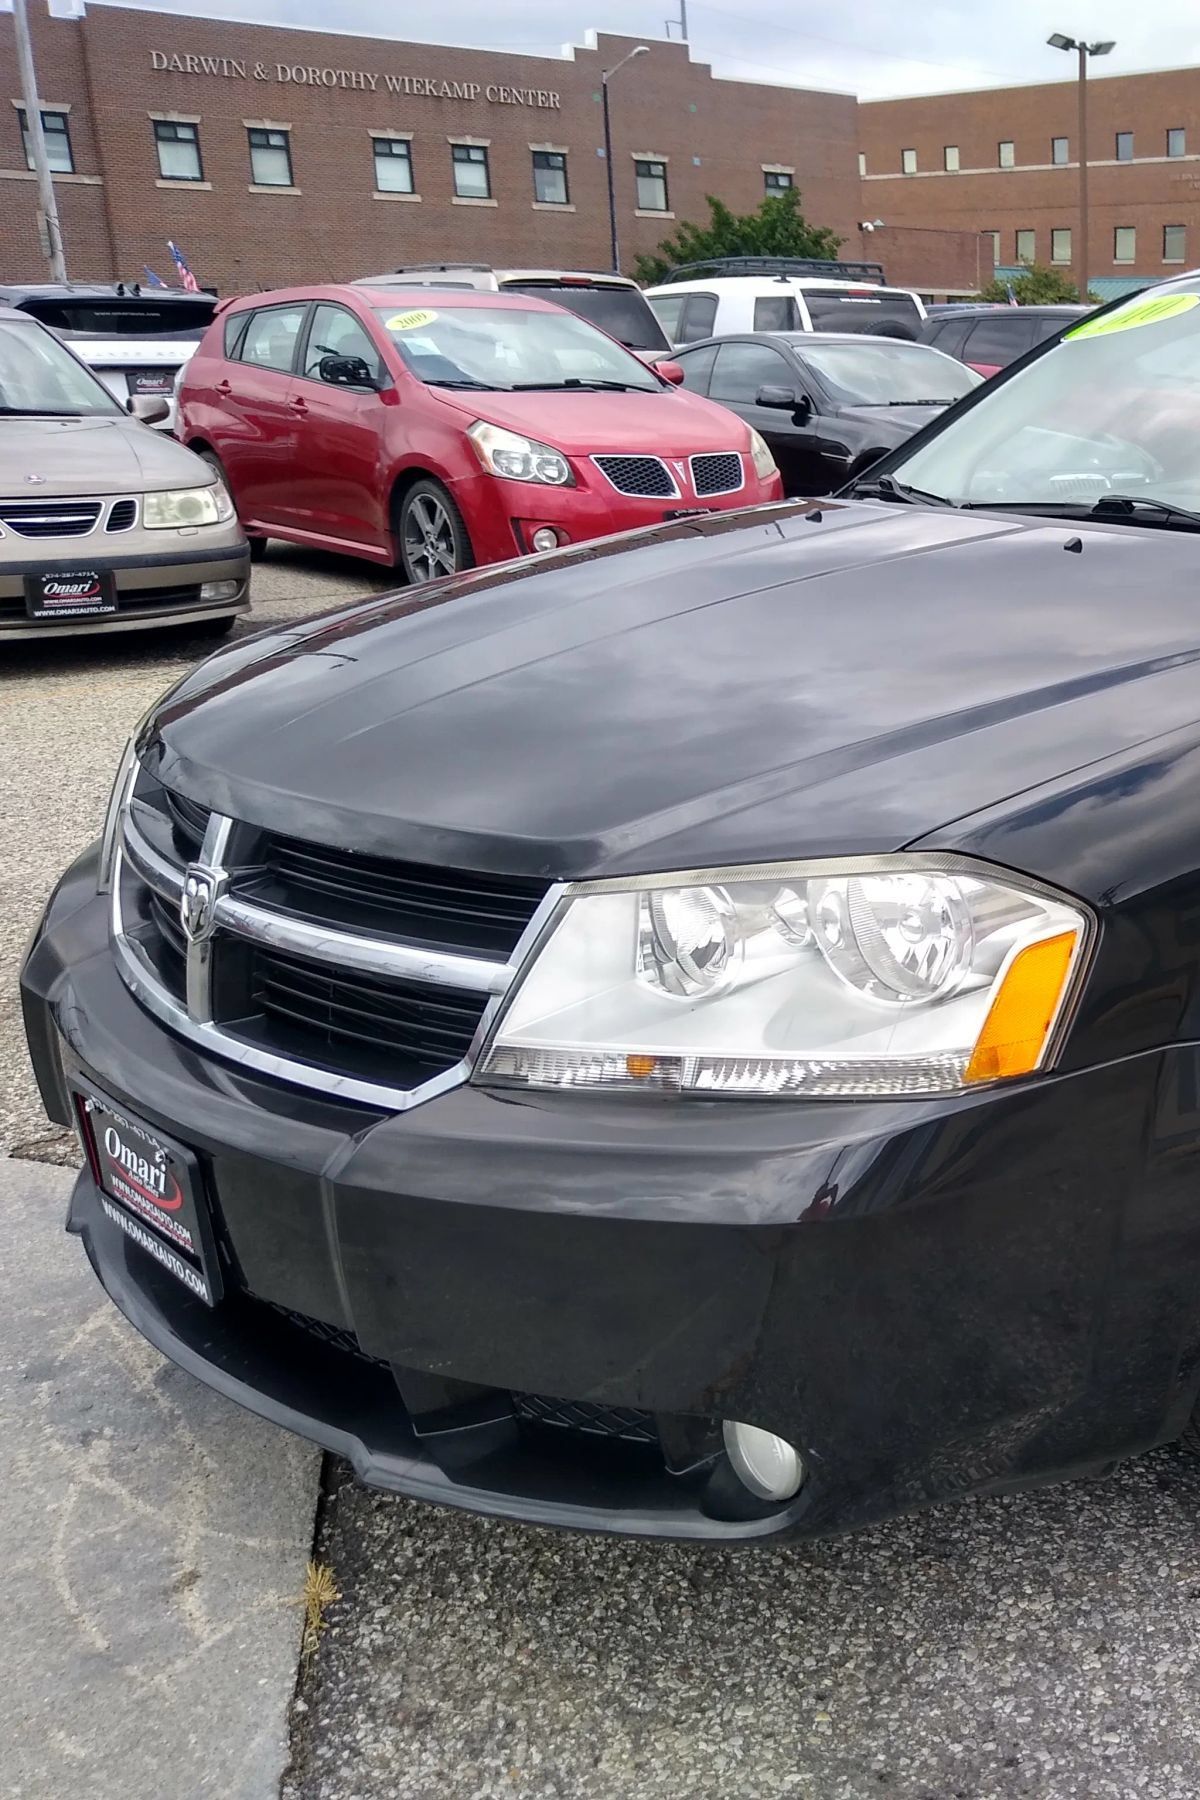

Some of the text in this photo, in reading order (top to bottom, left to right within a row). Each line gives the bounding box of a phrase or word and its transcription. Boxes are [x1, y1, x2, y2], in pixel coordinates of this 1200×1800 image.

[150, 50, 561, 109] DARWIN & DOROTHY WIEKAMP CENTER
[43, 580, 93, 595] Omari
[105, 1127, 167, 1195] Omari
[102, 1199, 209, 1301] WWW.OMARIAUTO.COM
